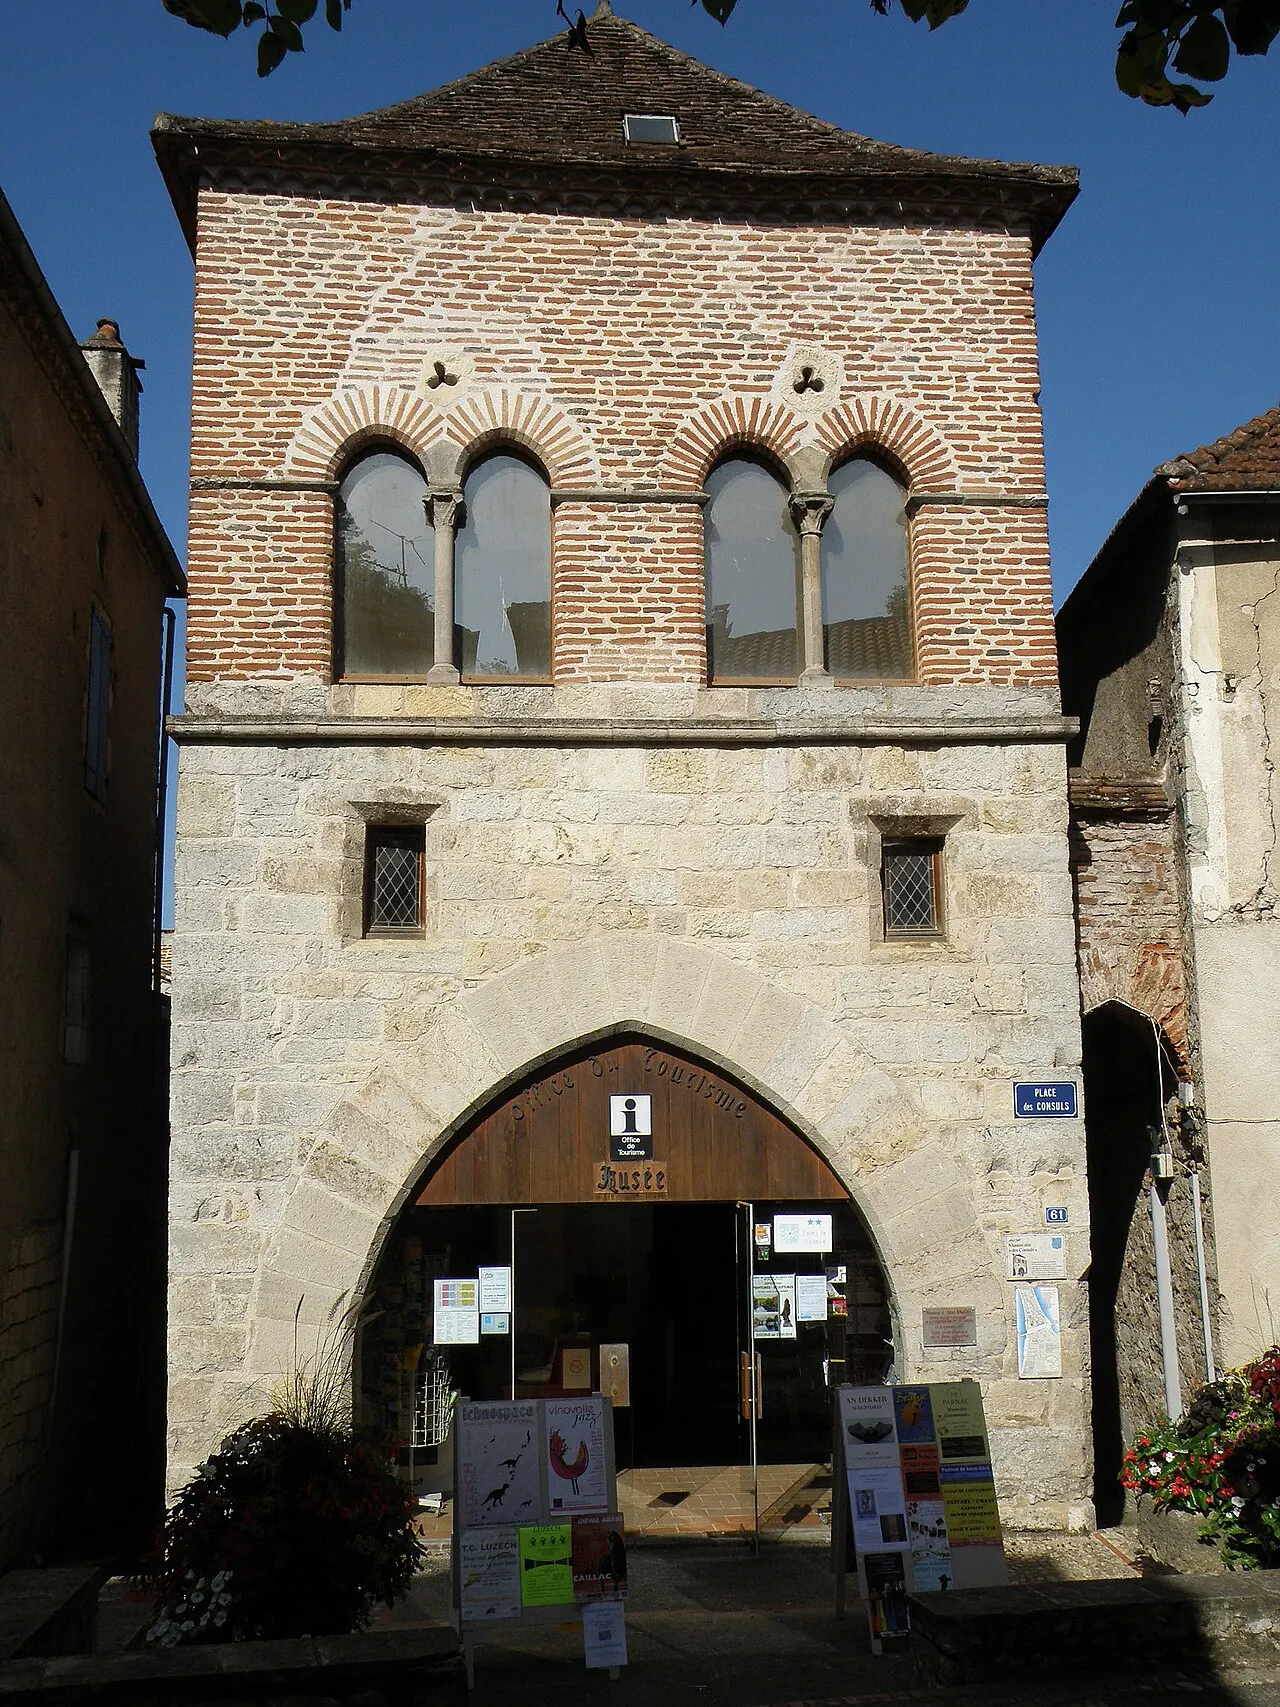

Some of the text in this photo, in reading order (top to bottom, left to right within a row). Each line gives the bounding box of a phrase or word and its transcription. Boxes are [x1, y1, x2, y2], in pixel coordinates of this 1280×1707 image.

[1034, 1088, 1057, 1098] PLACE
[1023, 1101, 1070, 1112] des CONSULS
[621, 1136, 641, 1144] Office
[1050, 1209, 1064, 1220] 61
[462, 1405, 534, 1421] ichnospace
[572, 1412, 602, 1428] jazz
[480, 1542, 517, 1551] LUZECH
[573, 1572, 612, 1582] CAILLAC
